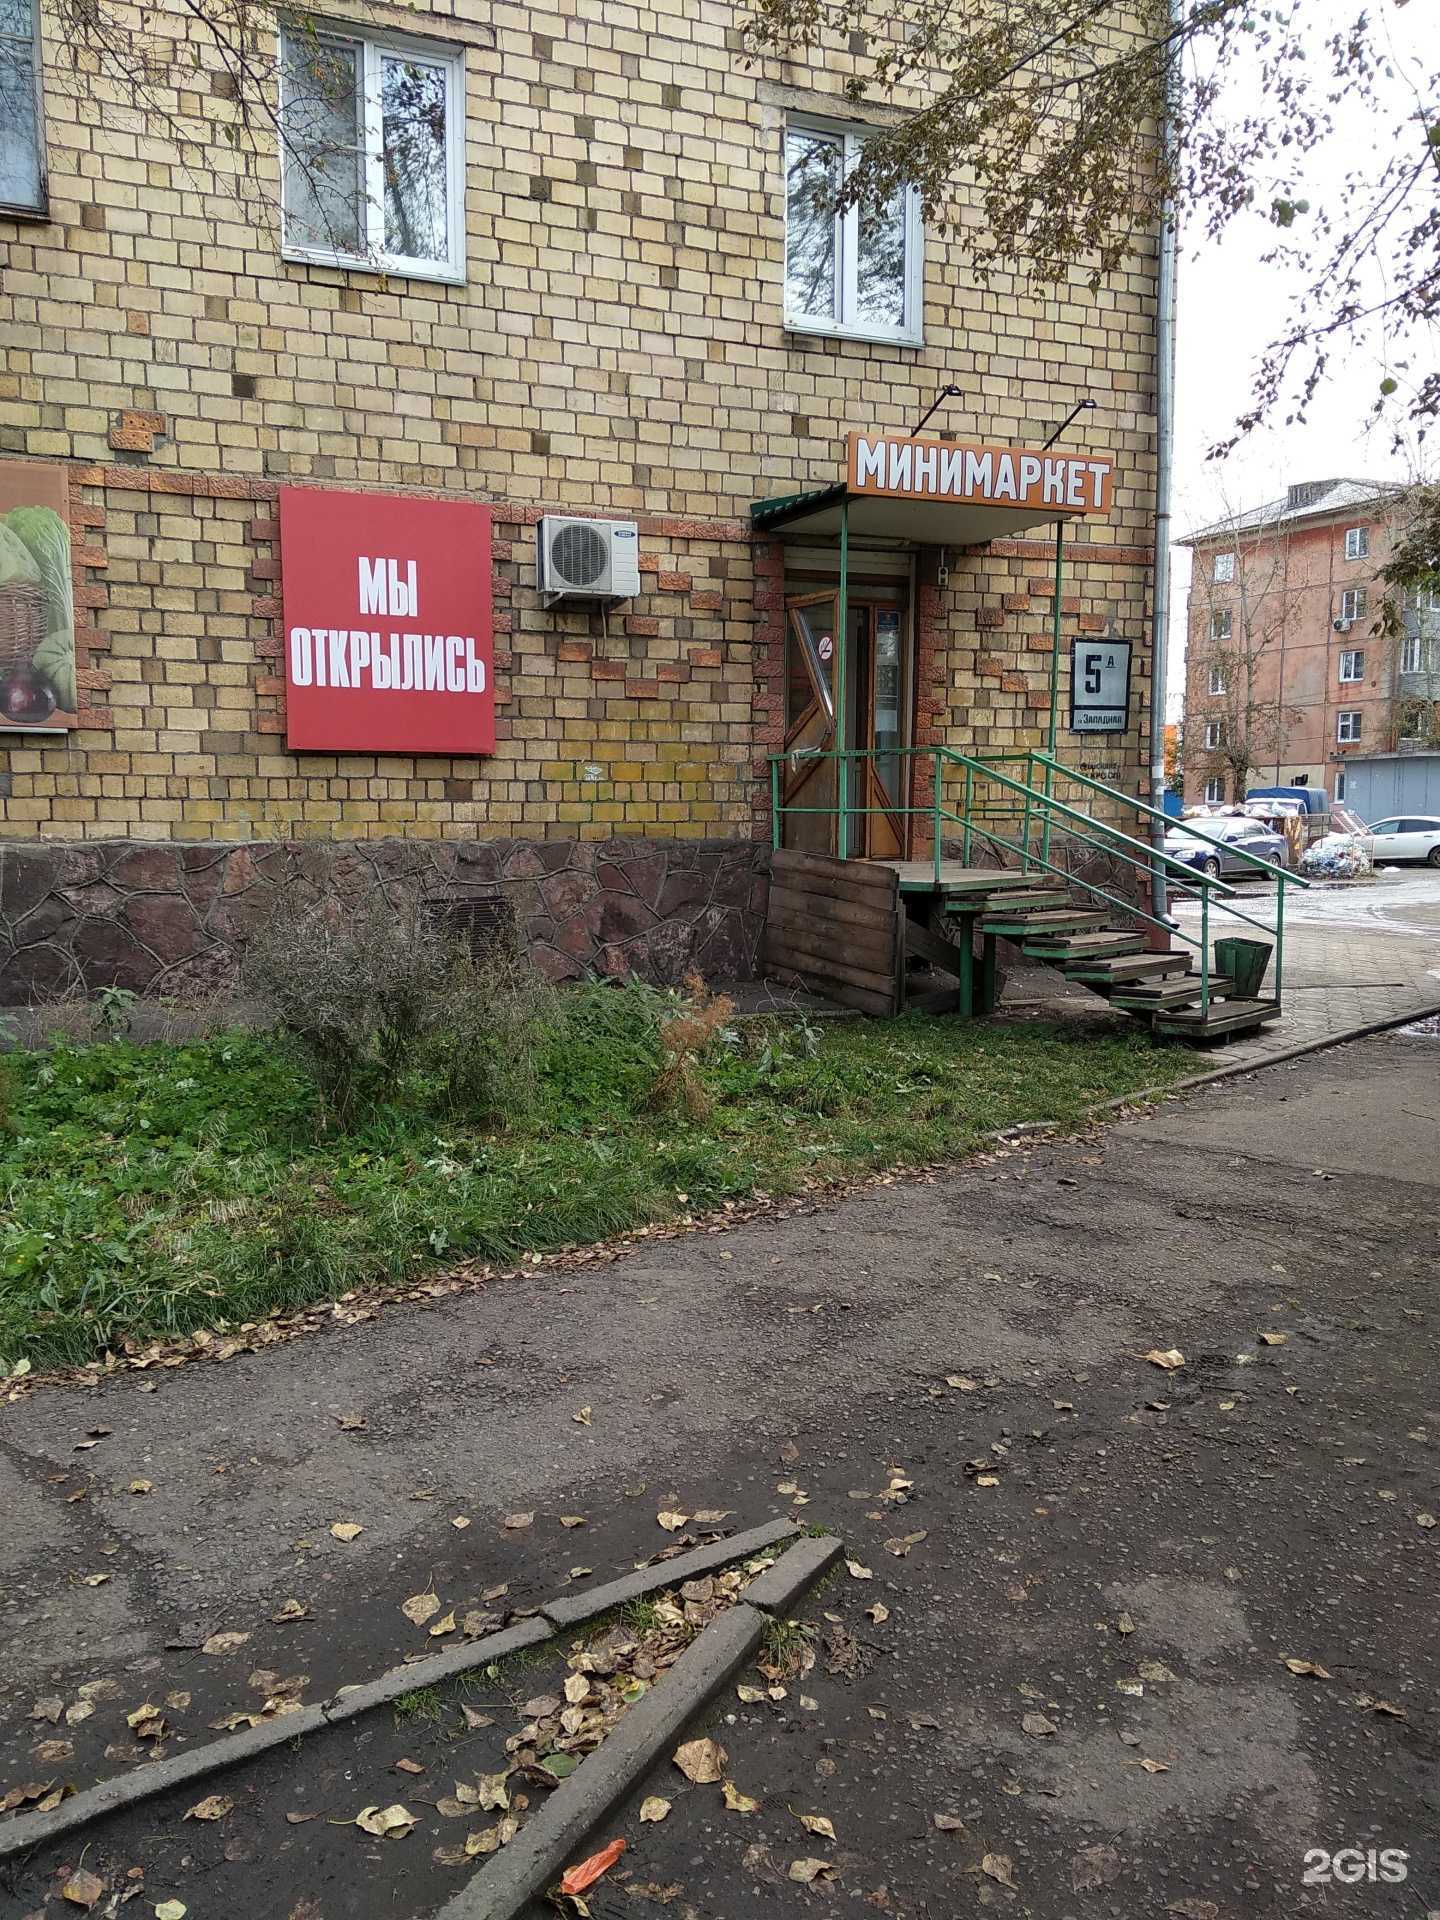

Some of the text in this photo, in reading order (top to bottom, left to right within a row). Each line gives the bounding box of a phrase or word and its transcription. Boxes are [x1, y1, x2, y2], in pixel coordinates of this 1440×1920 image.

[856, 438, 1111, 508] МИНИМАРКЕТ
[358, 556, 418, 617] МЫ
[290, 627, 486, 693] ОТКРЫЛИСЬ
